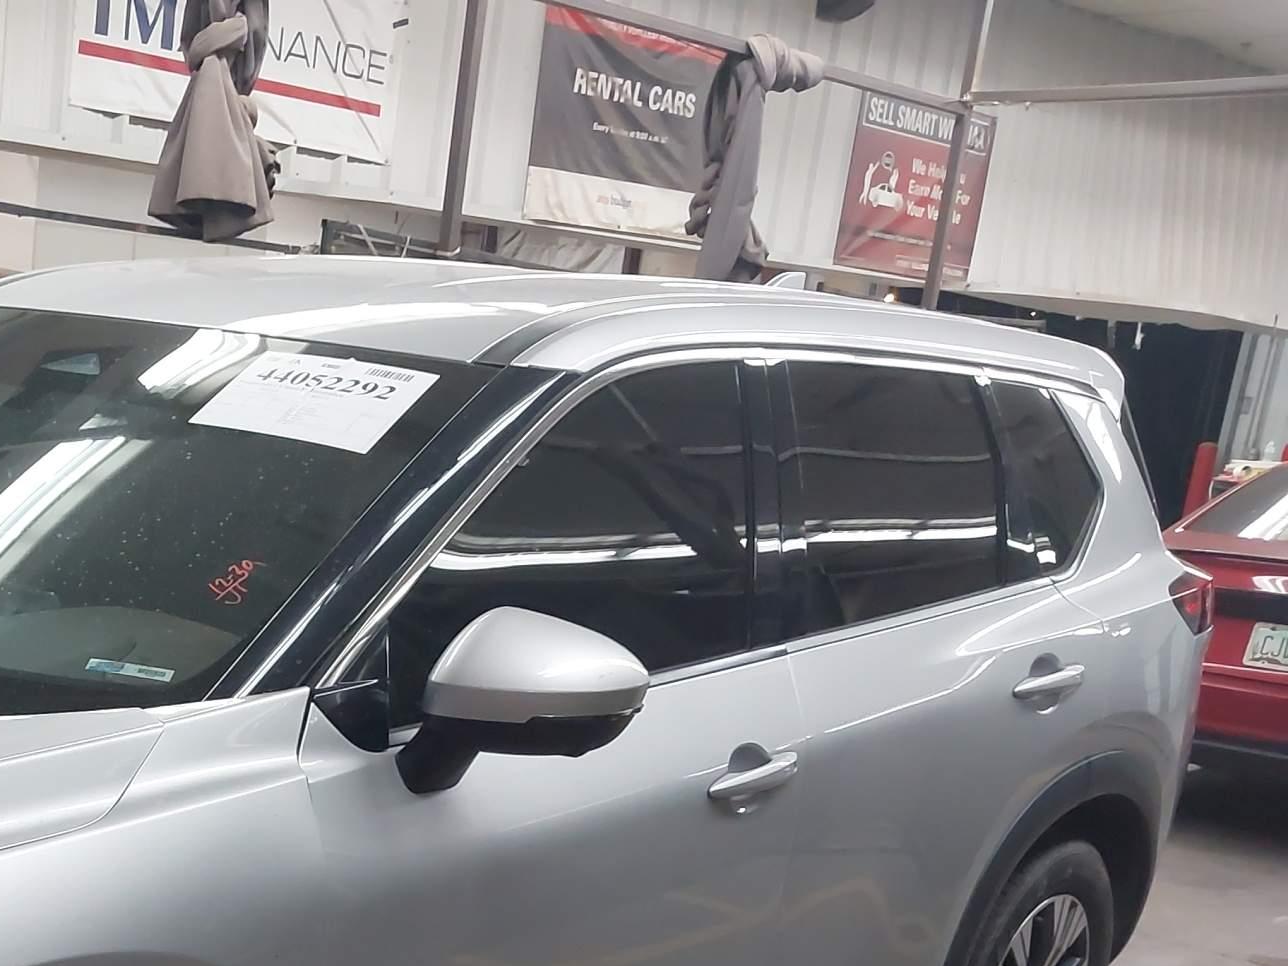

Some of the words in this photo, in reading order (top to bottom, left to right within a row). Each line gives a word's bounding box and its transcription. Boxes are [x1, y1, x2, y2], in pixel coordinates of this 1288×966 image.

[266, 26, 388, 85] NANCE
[573, 67, 643, 108] RENTAL
[648, 85, 697, 119] CARS
[868, 96, 895, 126] SELL
[896, 104, 939, 137] SMART
[938, 115, 957, 141] WI
[912, 157, 928, 176] We
[907, 178, 931, 198] Earn
[906, 199, 926, 218] Your
[256, 367, 398, 401] 44052292
